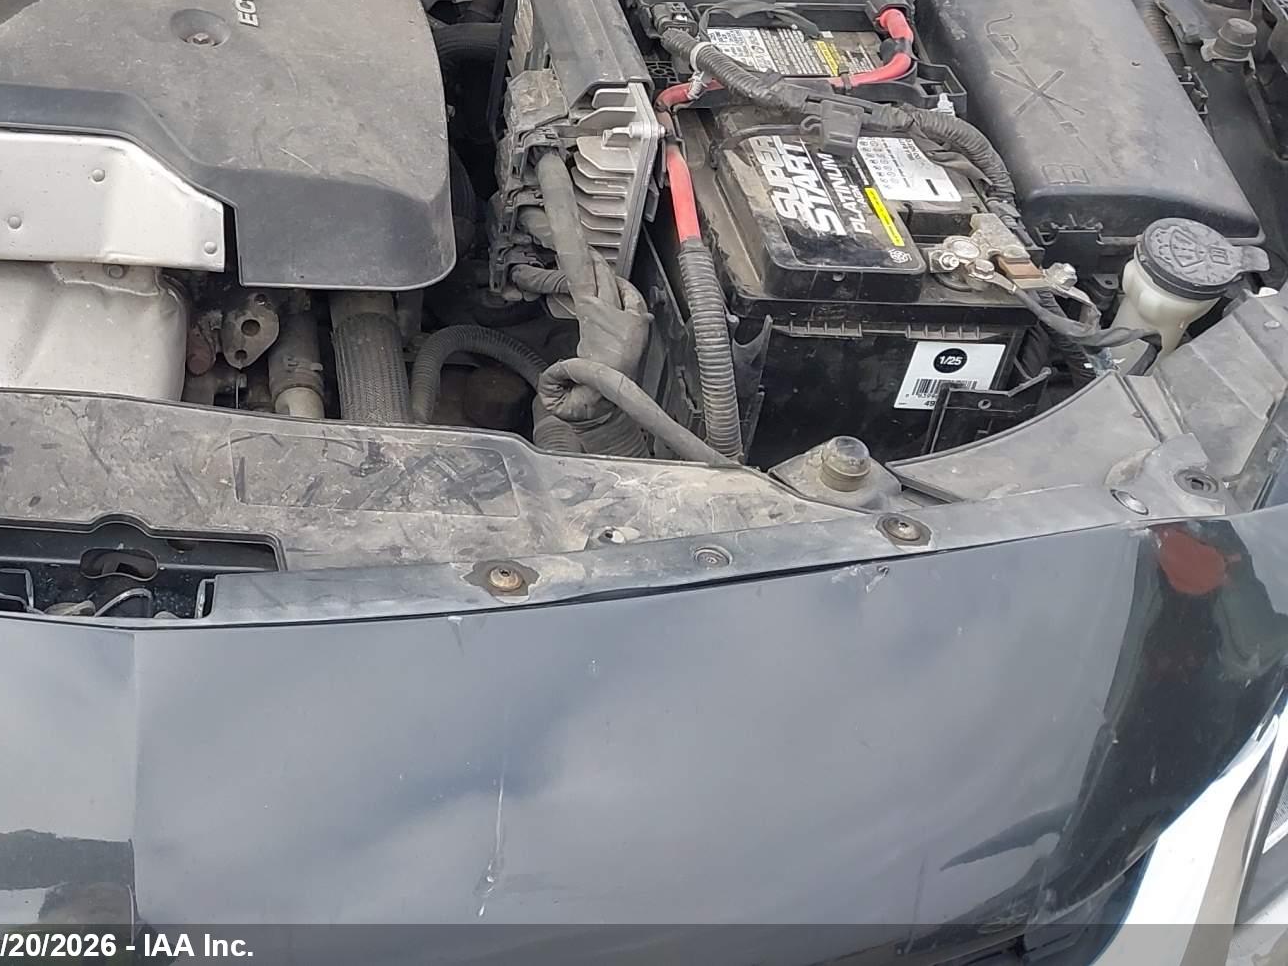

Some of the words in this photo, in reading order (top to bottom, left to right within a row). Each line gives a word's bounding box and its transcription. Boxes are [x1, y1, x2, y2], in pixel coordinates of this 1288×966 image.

[748, 135, 801, 220] SUPER
[772, 135, 848, 236] START
[816, 152, 872, 234] PLATINUM
[939, 356, 962, 365] 1/25
